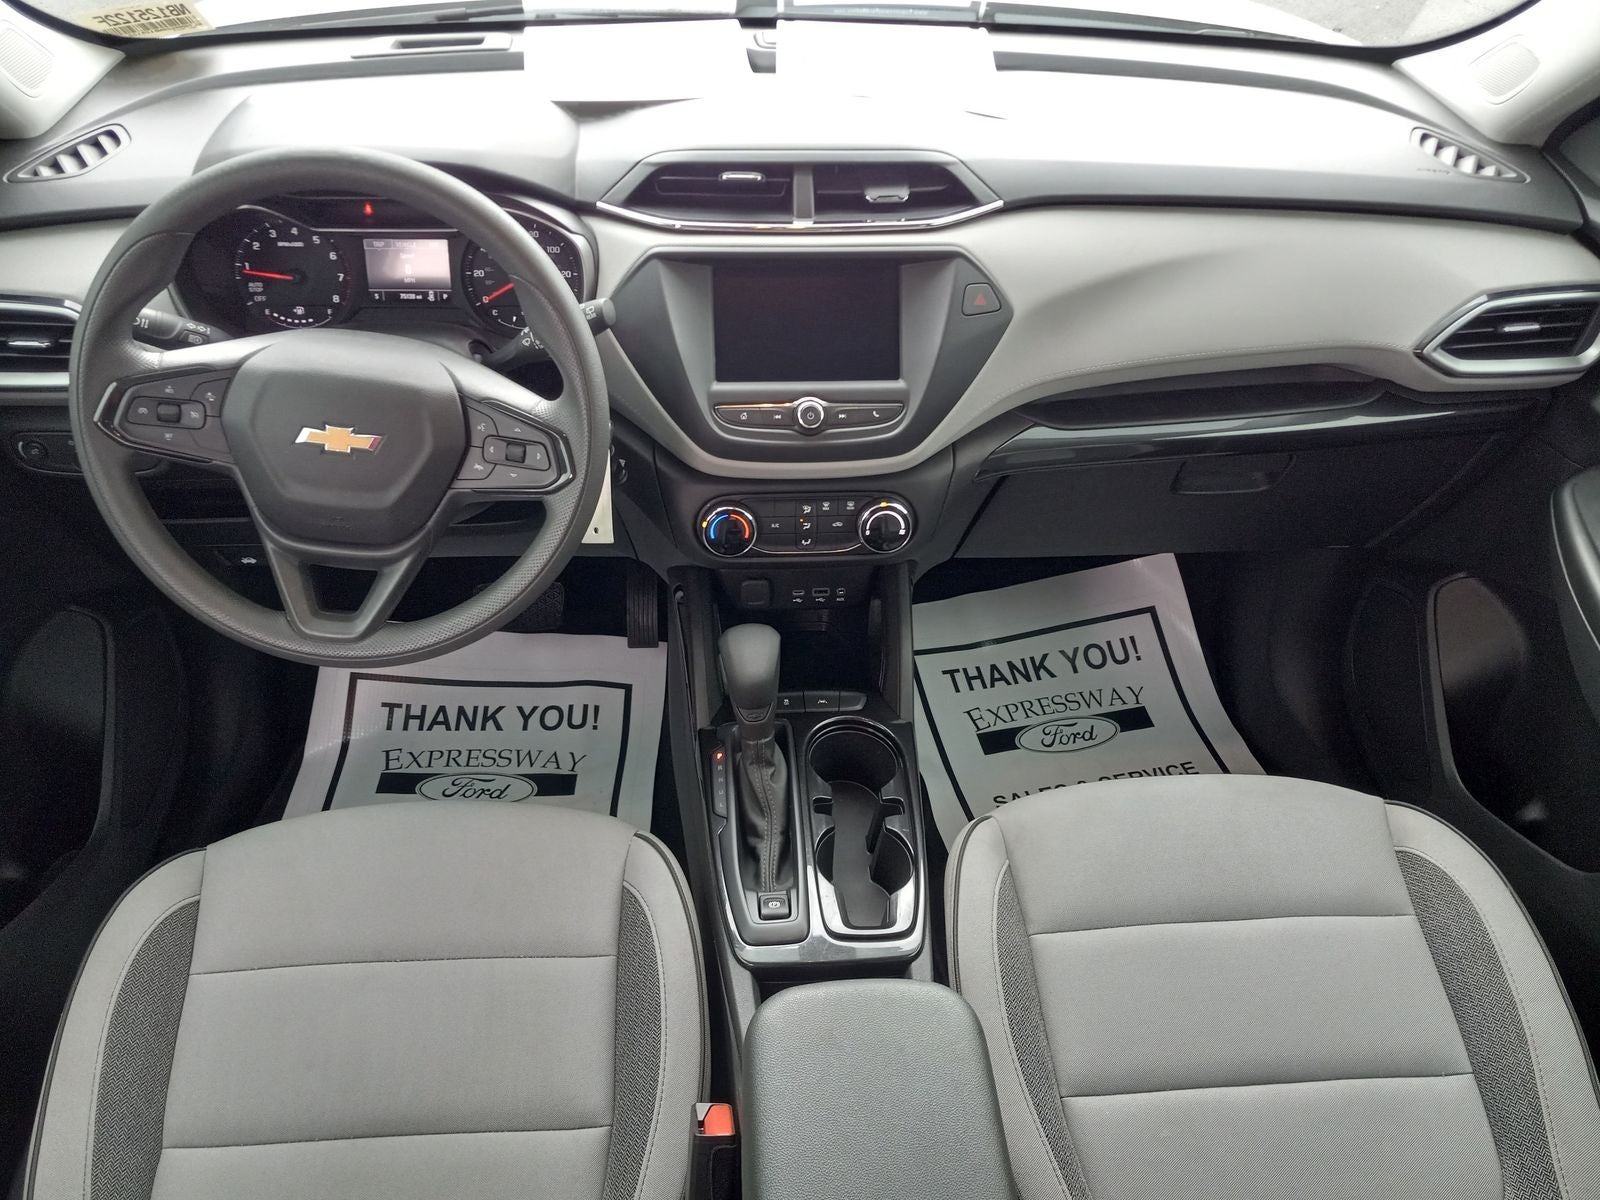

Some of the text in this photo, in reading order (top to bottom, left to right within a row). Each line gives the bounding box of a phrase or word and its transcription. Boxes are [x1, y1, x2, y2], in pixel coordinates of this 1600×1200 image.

[269, 230, 277, 238] 3
[291, 227, 298, 235] 4
[312, 236, 320, 244] 5
[252, 242, 261, 250] 2
[546, 246, 560, 254] 100
[329, 252, 337, 260] 6
[244, 262, 250, 270] 1
[337, 274, 344, 282] 7
[561, 270, 572, 278] 20
[332, 295, 340, 303] 8
[941, 635, 1142, 693] THANK YOU!
[380, 702, 600, 732] THANK YOU!
[1041, 722, 1098, 748] Ford
[1099, 761, 1200, 781] VICE
[441, 776, 512, 801] Ford
